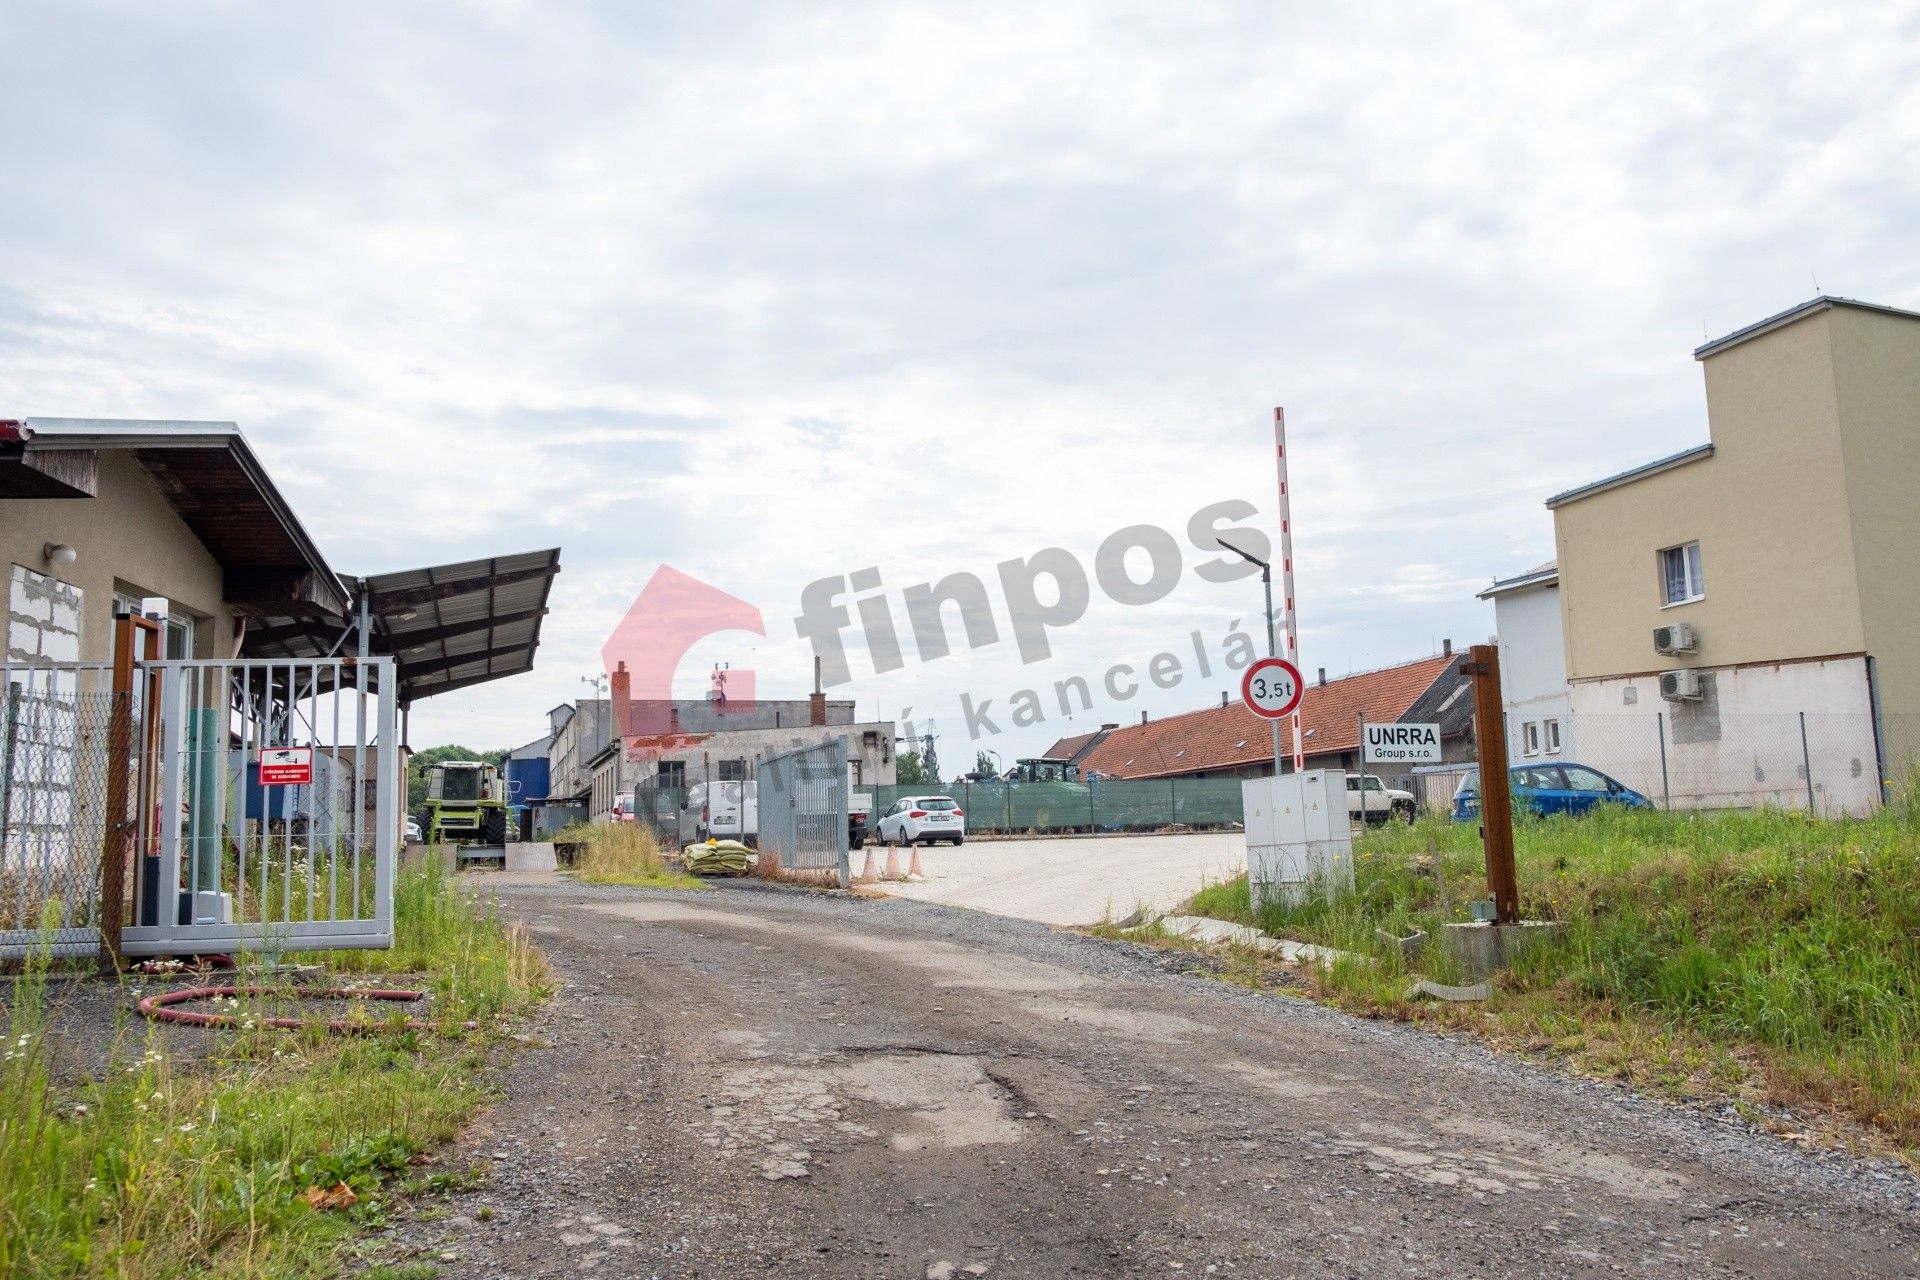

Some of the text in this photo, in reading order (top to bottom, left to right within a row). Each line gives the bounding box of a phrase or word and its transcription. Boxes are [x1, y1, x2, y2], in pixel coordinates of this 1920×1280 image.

[1369, 727, 1436, 746] UNRRA
[1374, 747, 1433, 760] Group s.r.o.
